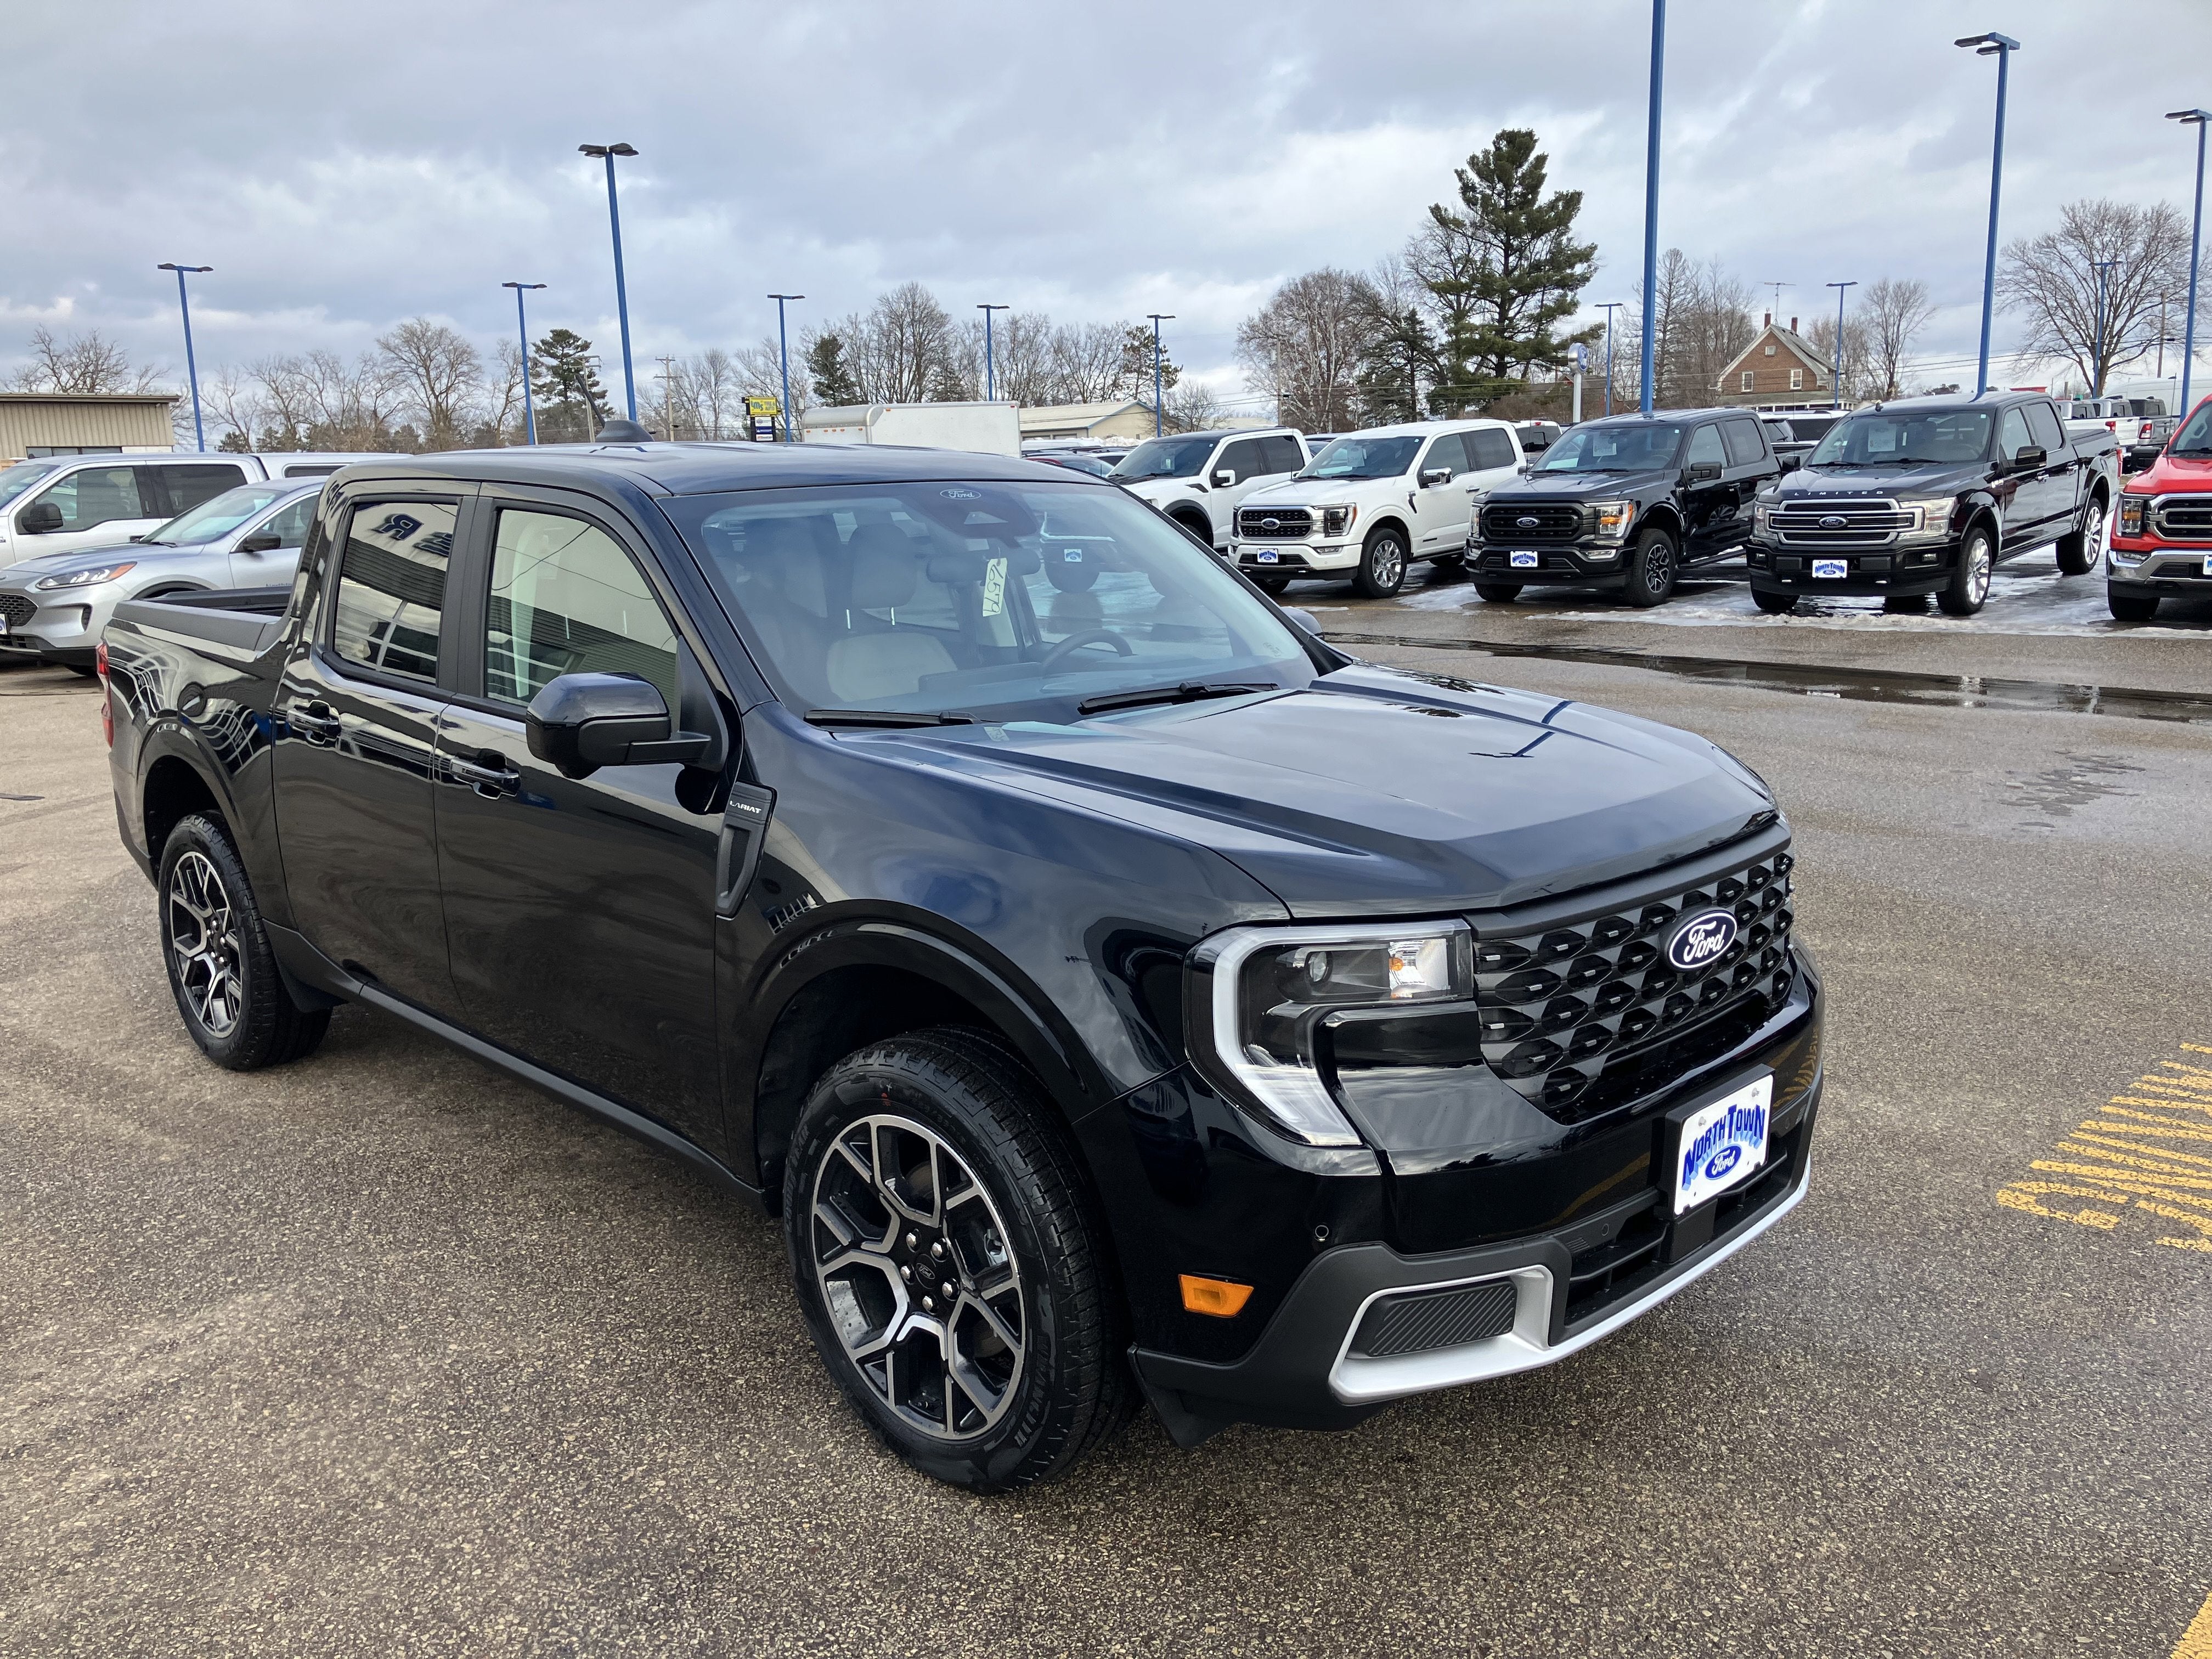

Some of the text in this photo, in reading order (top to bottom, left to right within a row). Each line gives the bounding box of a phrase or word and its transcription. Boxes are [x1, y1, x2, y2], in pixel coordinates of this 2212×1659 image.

[982, 564, 1004, 613] 6579
[730, 800, 762, 814] LARIAT
[1683, 921, 1726, 962] Ford
[1711, 1149, 1736, 1176] Ford
[919, 1265, 932, 1277] Ford
